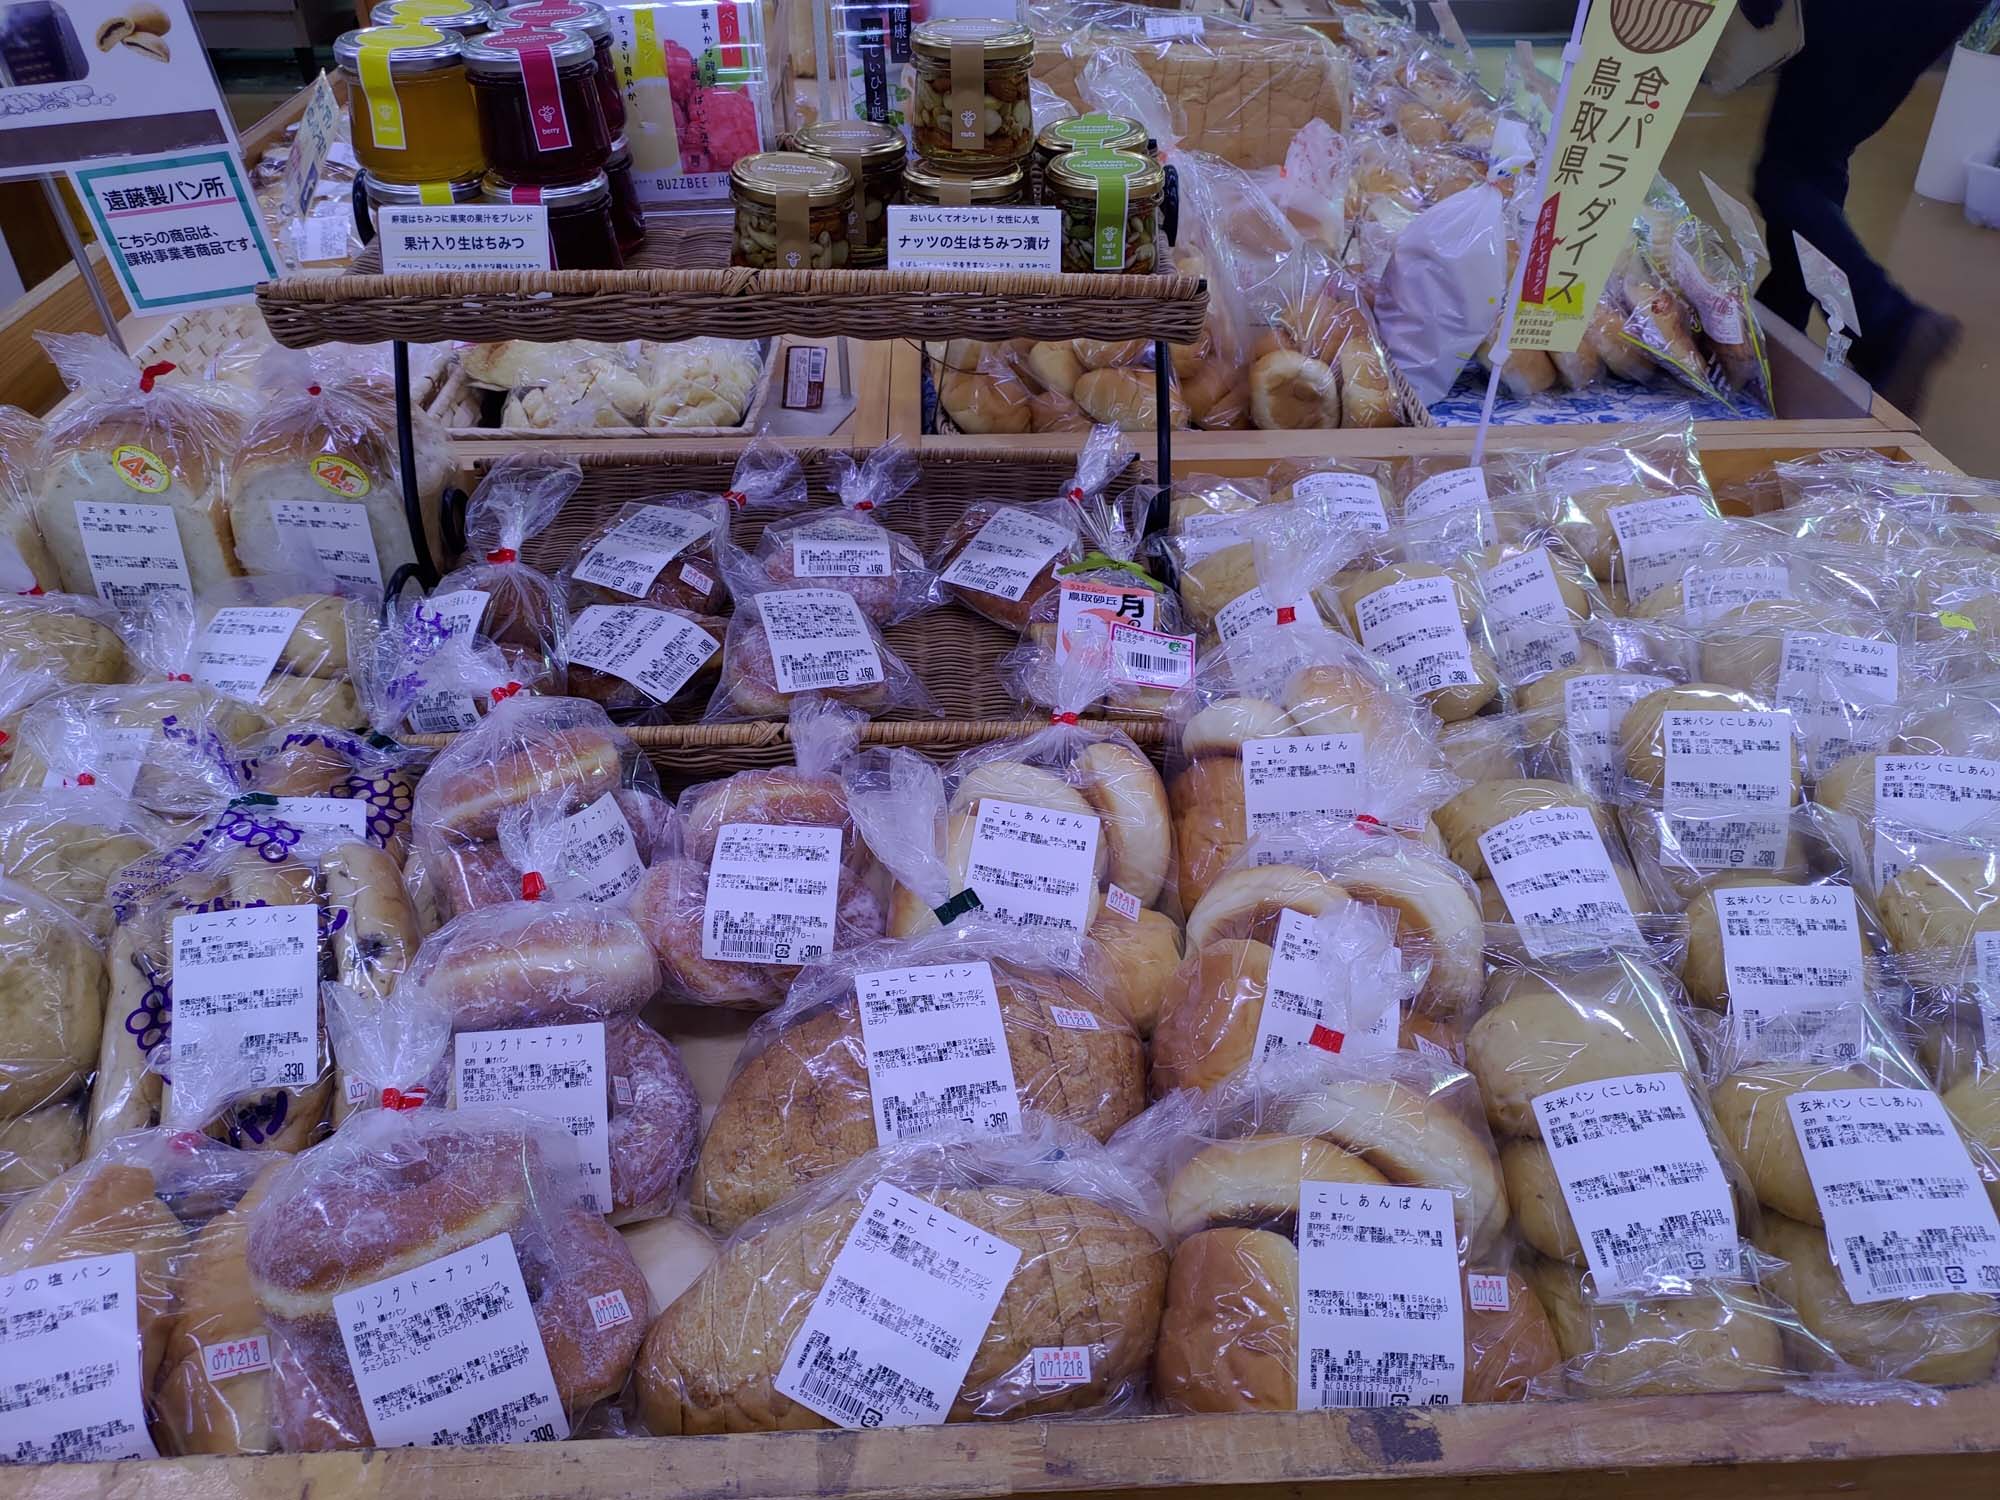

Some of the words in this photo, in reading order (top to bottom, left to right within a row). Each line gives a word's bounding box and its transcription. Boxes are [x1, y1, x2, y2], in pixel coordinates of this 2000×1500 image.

[541, 127, 560, 135] berry
[1553, 56, 1622, 187] 鳥取県
[656, 176, 709, 191] BUZZBEE
[1547, 65, 1669, 304] 食パラダイス
[102, 176, 226, 212] 遠藤製パン所
[909, 213, 1040, 225] おいしくてオシャレ！女性に人気
[117, 225, 219, 250] こちらの商品は、
[404, 236, 525, 251] 果汁入り生はちみつ
[898, 235, 1051, 251] ナッツの生はちみつ漬け
[124, 236, 258, 267] 課税事業者商品です。
[1068, 591, 1117, 606] 鳥取砂丘
[1361, 581, 1440, 609] 玄米パン（こしあん）
[1671, 717, 1774, 728] 玄米パン（こしあん）
[1256, 741, 1348, 754] こしあんぱん
[1884, 762, 1996, 776] 玄米パン（こしあん）
[282, 803, 350, 814] ズンパン
[992, 806, 1083, 828] こしあんぱん
[1487, 813, 1579, 843] 玄米パン（こしあん）
[1725, 895, 1838, 906] 玄米パン（こしあん）
[190, 914, 298, 933] レーズンパン
[870, 966, 972, 988] コーヒーパン
[472, 1033, 584, 1053] リングドーナッツ
[1542, 1077, 1667, 1114] 玄米パン（こしあん）
[1798, 1097, 1924, 1113] 玄米パン（こしあん）
[1318, 1191, 1432, 1211] こしあんぱん
[871, 1208, 886, 1220] 名称
[891, 1217, 917, 1235] 菓子パン
[886, 1195, 999, 1257] コーヒーパン
[1309, 1211, 1321, 1220] 名称
[1330, 1212, 1355, 1222] 菓子パン
[355, 1250, 492, 1316] リングドーナッツ
[376, 1304, 407, 1323] 揚げパン
[1040, 1360, 1084, 1377] 071218
